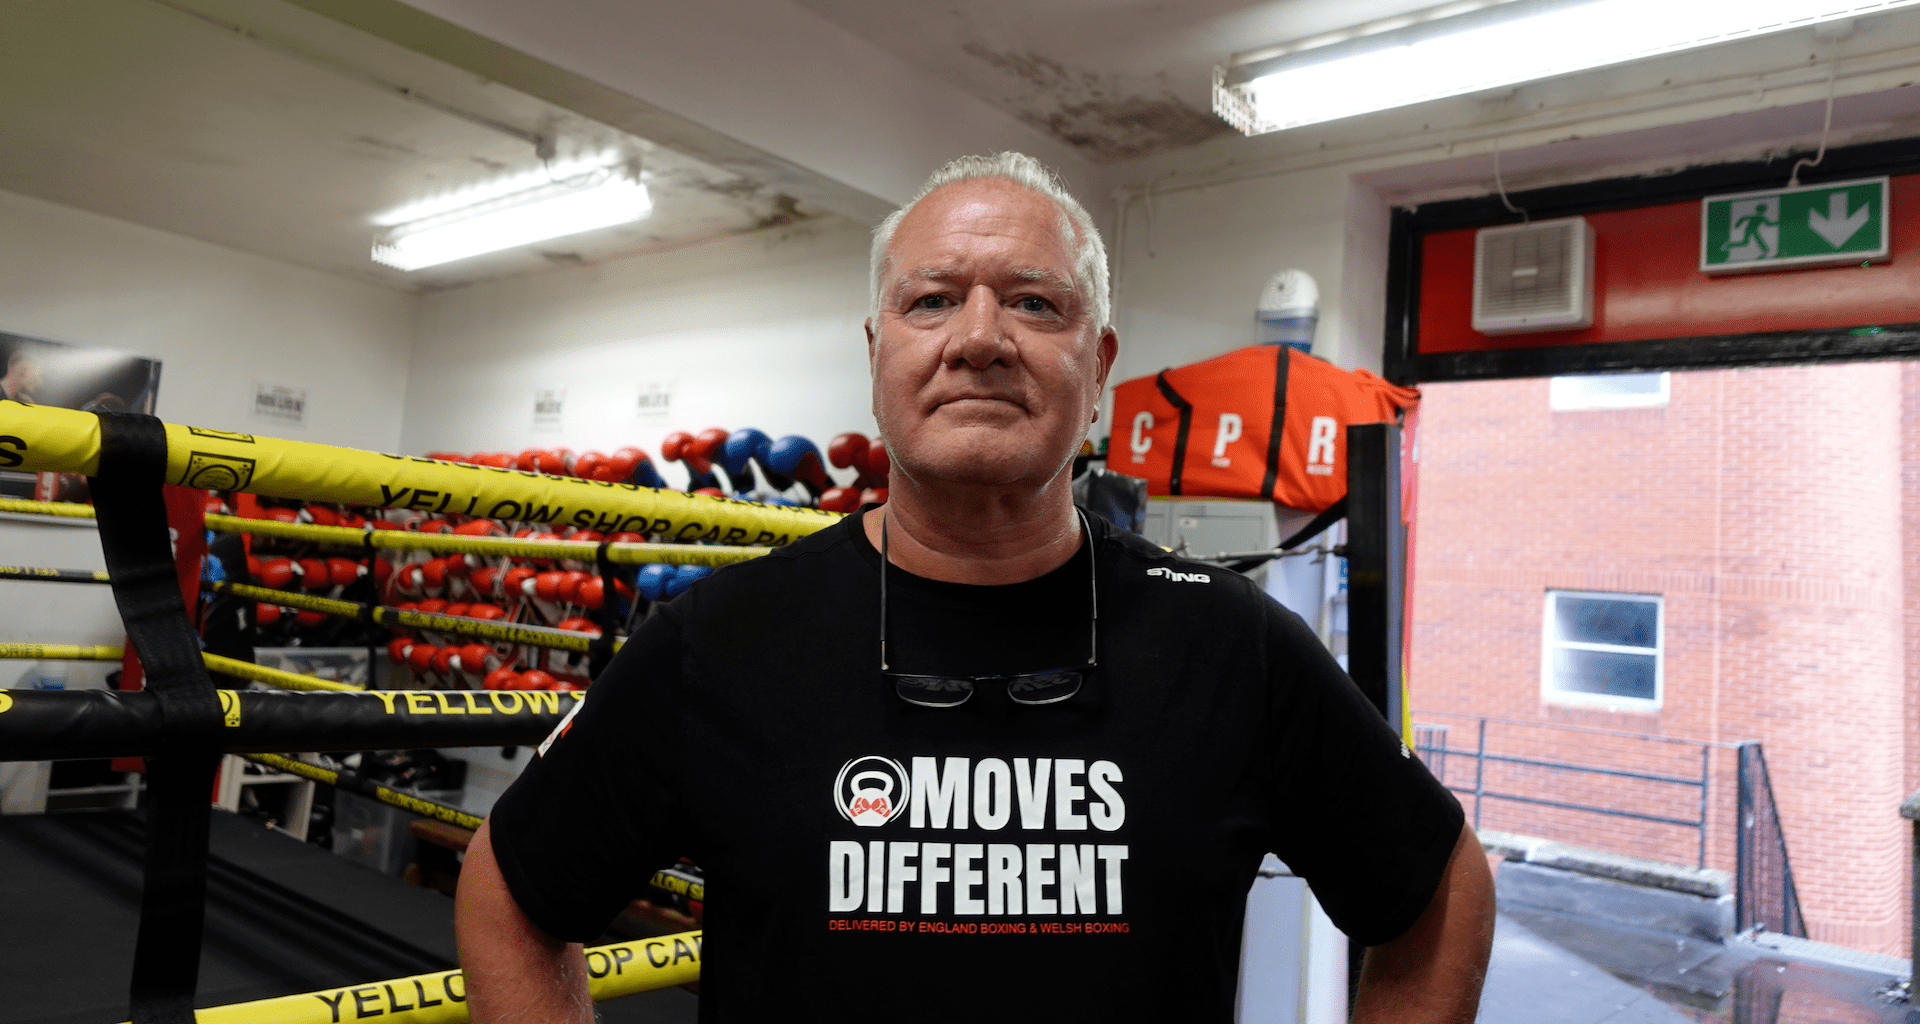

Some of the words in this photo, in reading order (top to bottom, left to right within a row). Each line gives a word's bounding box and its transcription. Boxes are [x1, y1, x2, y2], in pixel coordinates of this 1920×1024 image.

[1131, 411, 1154, 454] C
[1213, 413, 1243, 457] P
[1307, 416, 1338, 464] R
[380, 484, 564, 523] YELLOW
[571, 509, 672, 536] SHOP
[674, 522, 748, 547] CAR
[749, 530, 806, 547] PA
[1146, 567, 1211, 583] STING
[371, 690, 559, 714] YELLOW
[910, 756, 1126, 831] MOVES
[829, 841, 1129, 915] DIFFERENT
[829, 920, 896, 931] DELIVERED
[899, 921, 916, 932] BY
[919, 922, 978, 934] ENGLAND
[980, 922, 1026, 934] BOXING
[1029, 923, 1037, 933] &
[1040, 923, 1082, 933] WELSH
[1084, 922, 1130, 934] BOXING
[313, 975, 466, 1023] YELLO
[645, 936, 701, 968] CA
